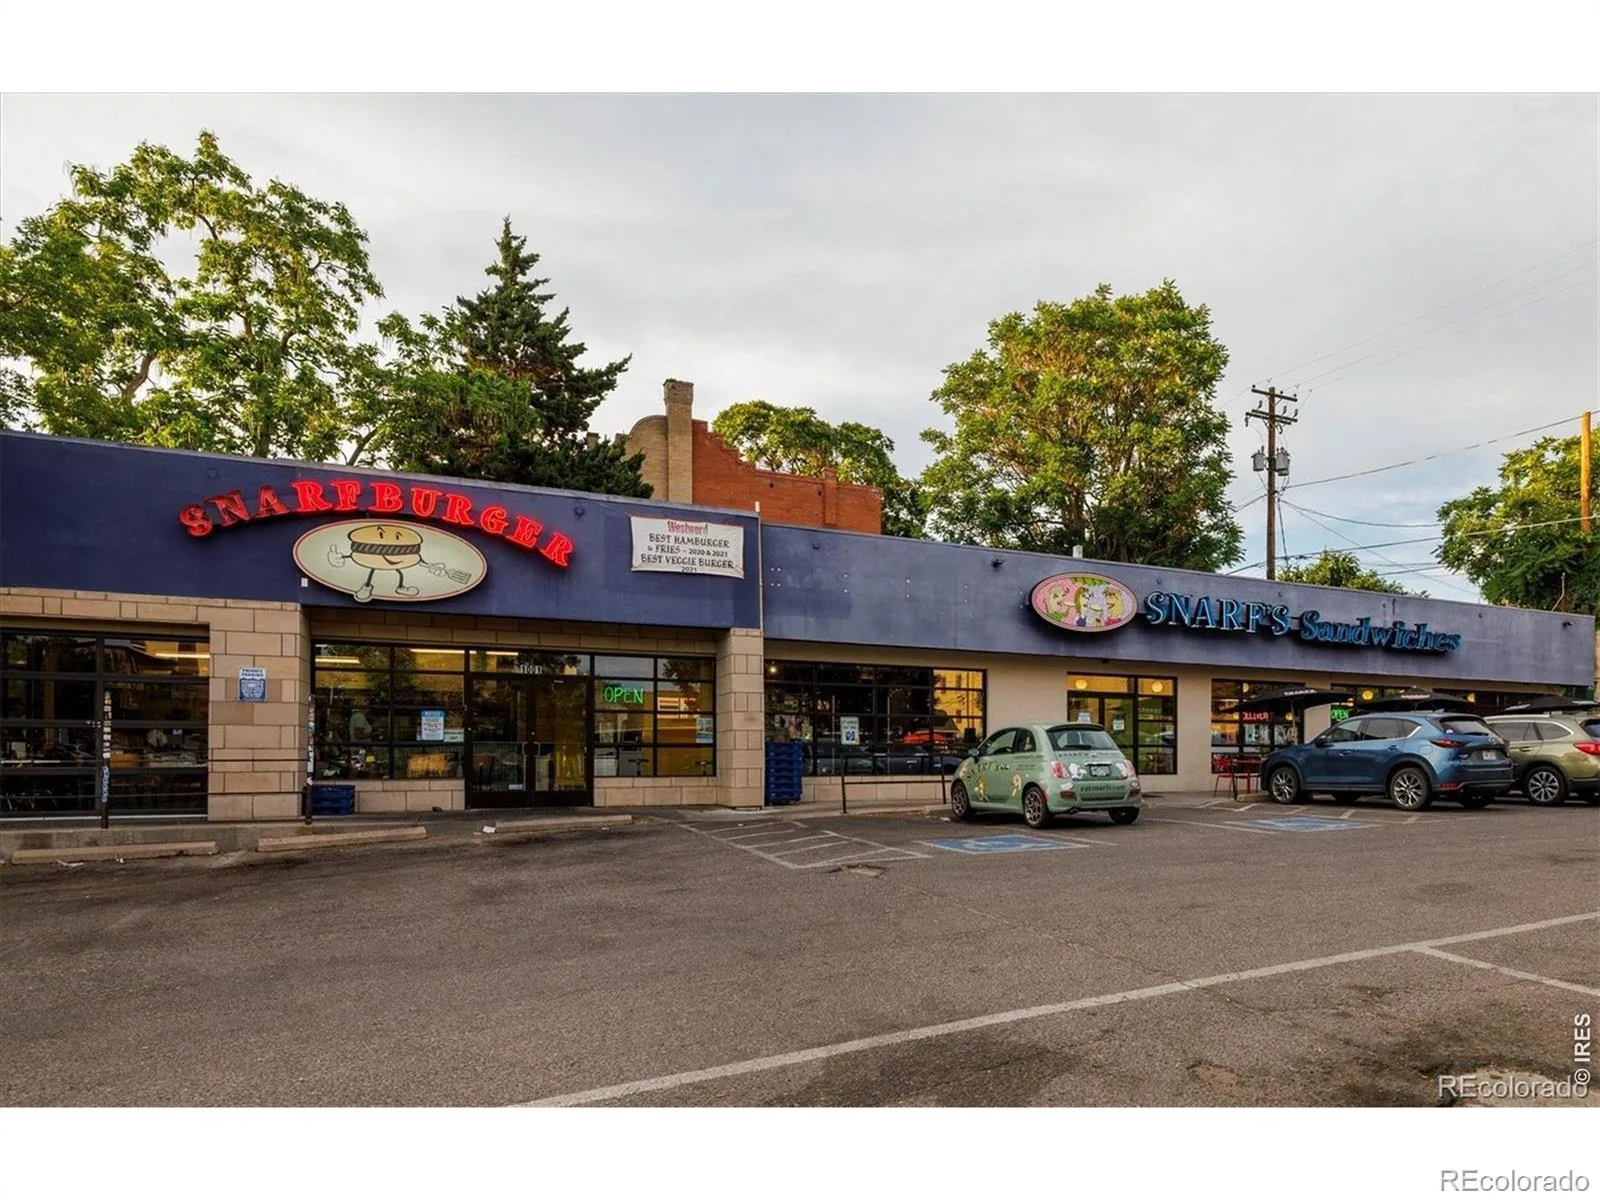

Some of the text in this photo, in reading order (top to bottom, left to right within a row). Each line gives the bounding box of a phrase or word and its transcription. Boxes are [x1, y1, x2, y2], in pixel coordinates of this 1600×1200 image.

[179, 479, 574, 569] SNARFBURGER
[667, 520, 708, 535] Westword
[649, 533, 730, 548] BEST HAMBURGER
[655, 545, 681, 554] FRIES
[688, 547, 705, 556] 2020
[712, 549, 728, 558] 2021
[641, 553, 734, 570] BEST VEGGIE BURGER
[1146, 590, 1462, 653] SNARF'S Sandwiches
[604, 686, 644, 704] OPEN
